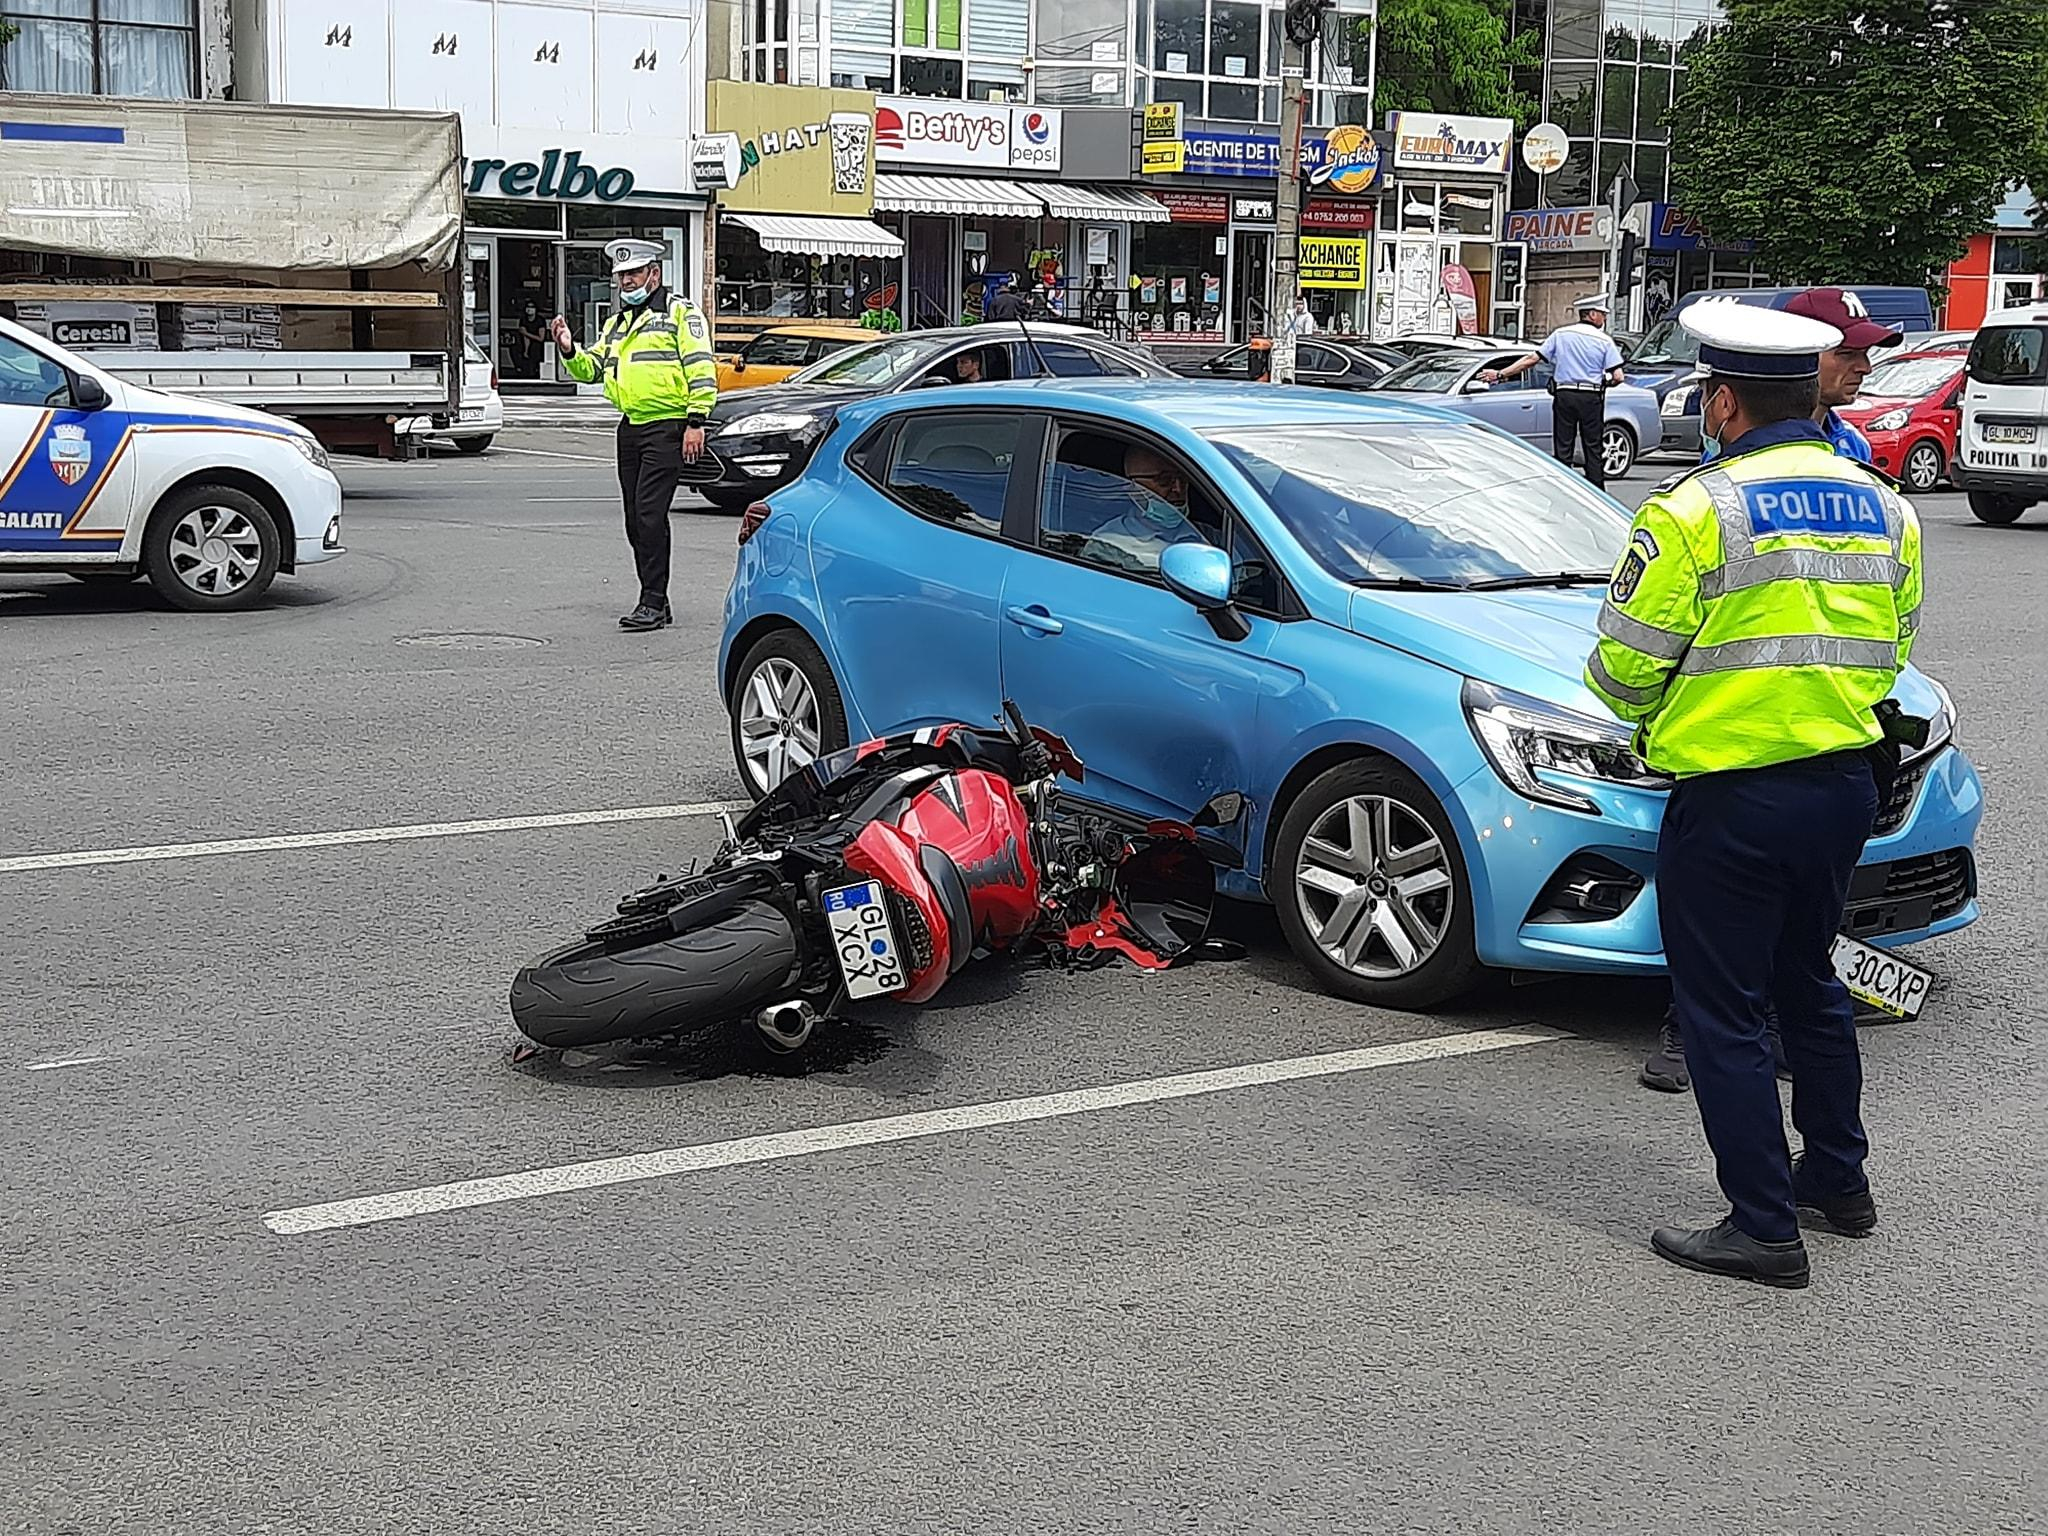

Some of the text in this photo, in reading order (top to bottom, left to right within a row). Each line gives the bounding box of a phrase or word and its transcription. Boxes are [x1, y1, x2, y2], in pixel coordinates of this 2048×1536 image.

[907, 111, 1005, 151] Betty's
[1011, 146, 1057, 165] pepsi
[1246, 142, 1266, 160] DE
[1268, 143, 1320, 163] TUSM
[463, 148, 635, 201] relbo
[1507, 211, 1595, 241] PAINE
[1299, 243, 1362, 266] XCHANGE
[56, 323, 128, 344] Ceresit
[1970, 449, 2020, 468] POLITIA
[1755, 490, 1878, 525] POLITIA
[0, 511, 63, 529] GALATI
[828, 891, 847, 911] RO
[834, 923, 874, 984] XCX
[860, 905, 902, 988] GL 28
